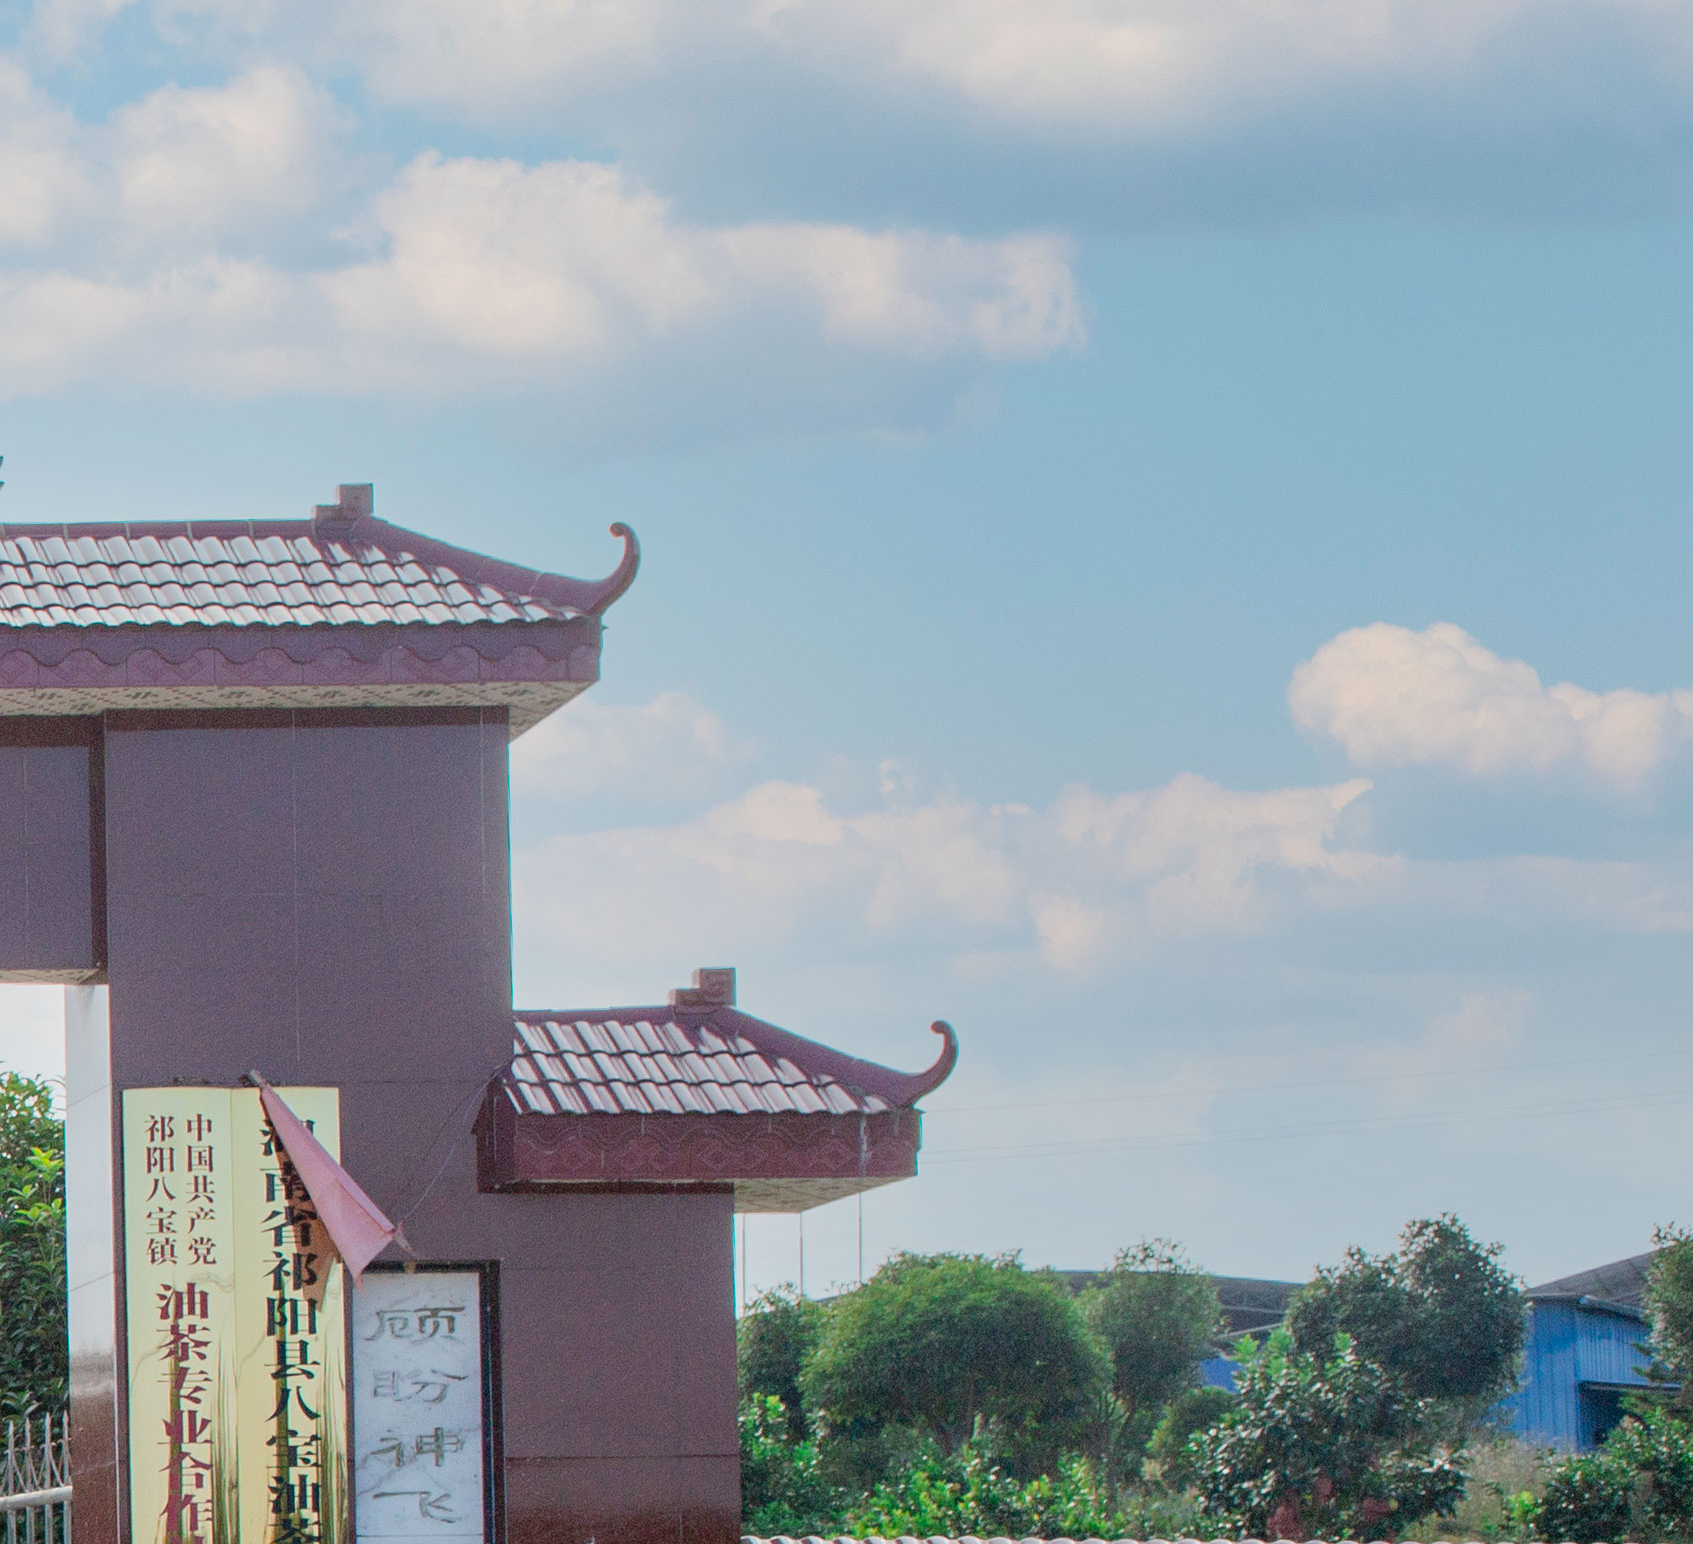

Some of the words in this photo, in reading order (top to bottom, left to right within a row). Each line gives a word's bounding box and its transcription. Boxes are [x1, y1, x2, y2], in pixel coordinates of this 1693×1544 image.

[144, 1113, 178, 1267] 祁阳八宝镇
[185, 1113, 217, 1267] 中国共产党
